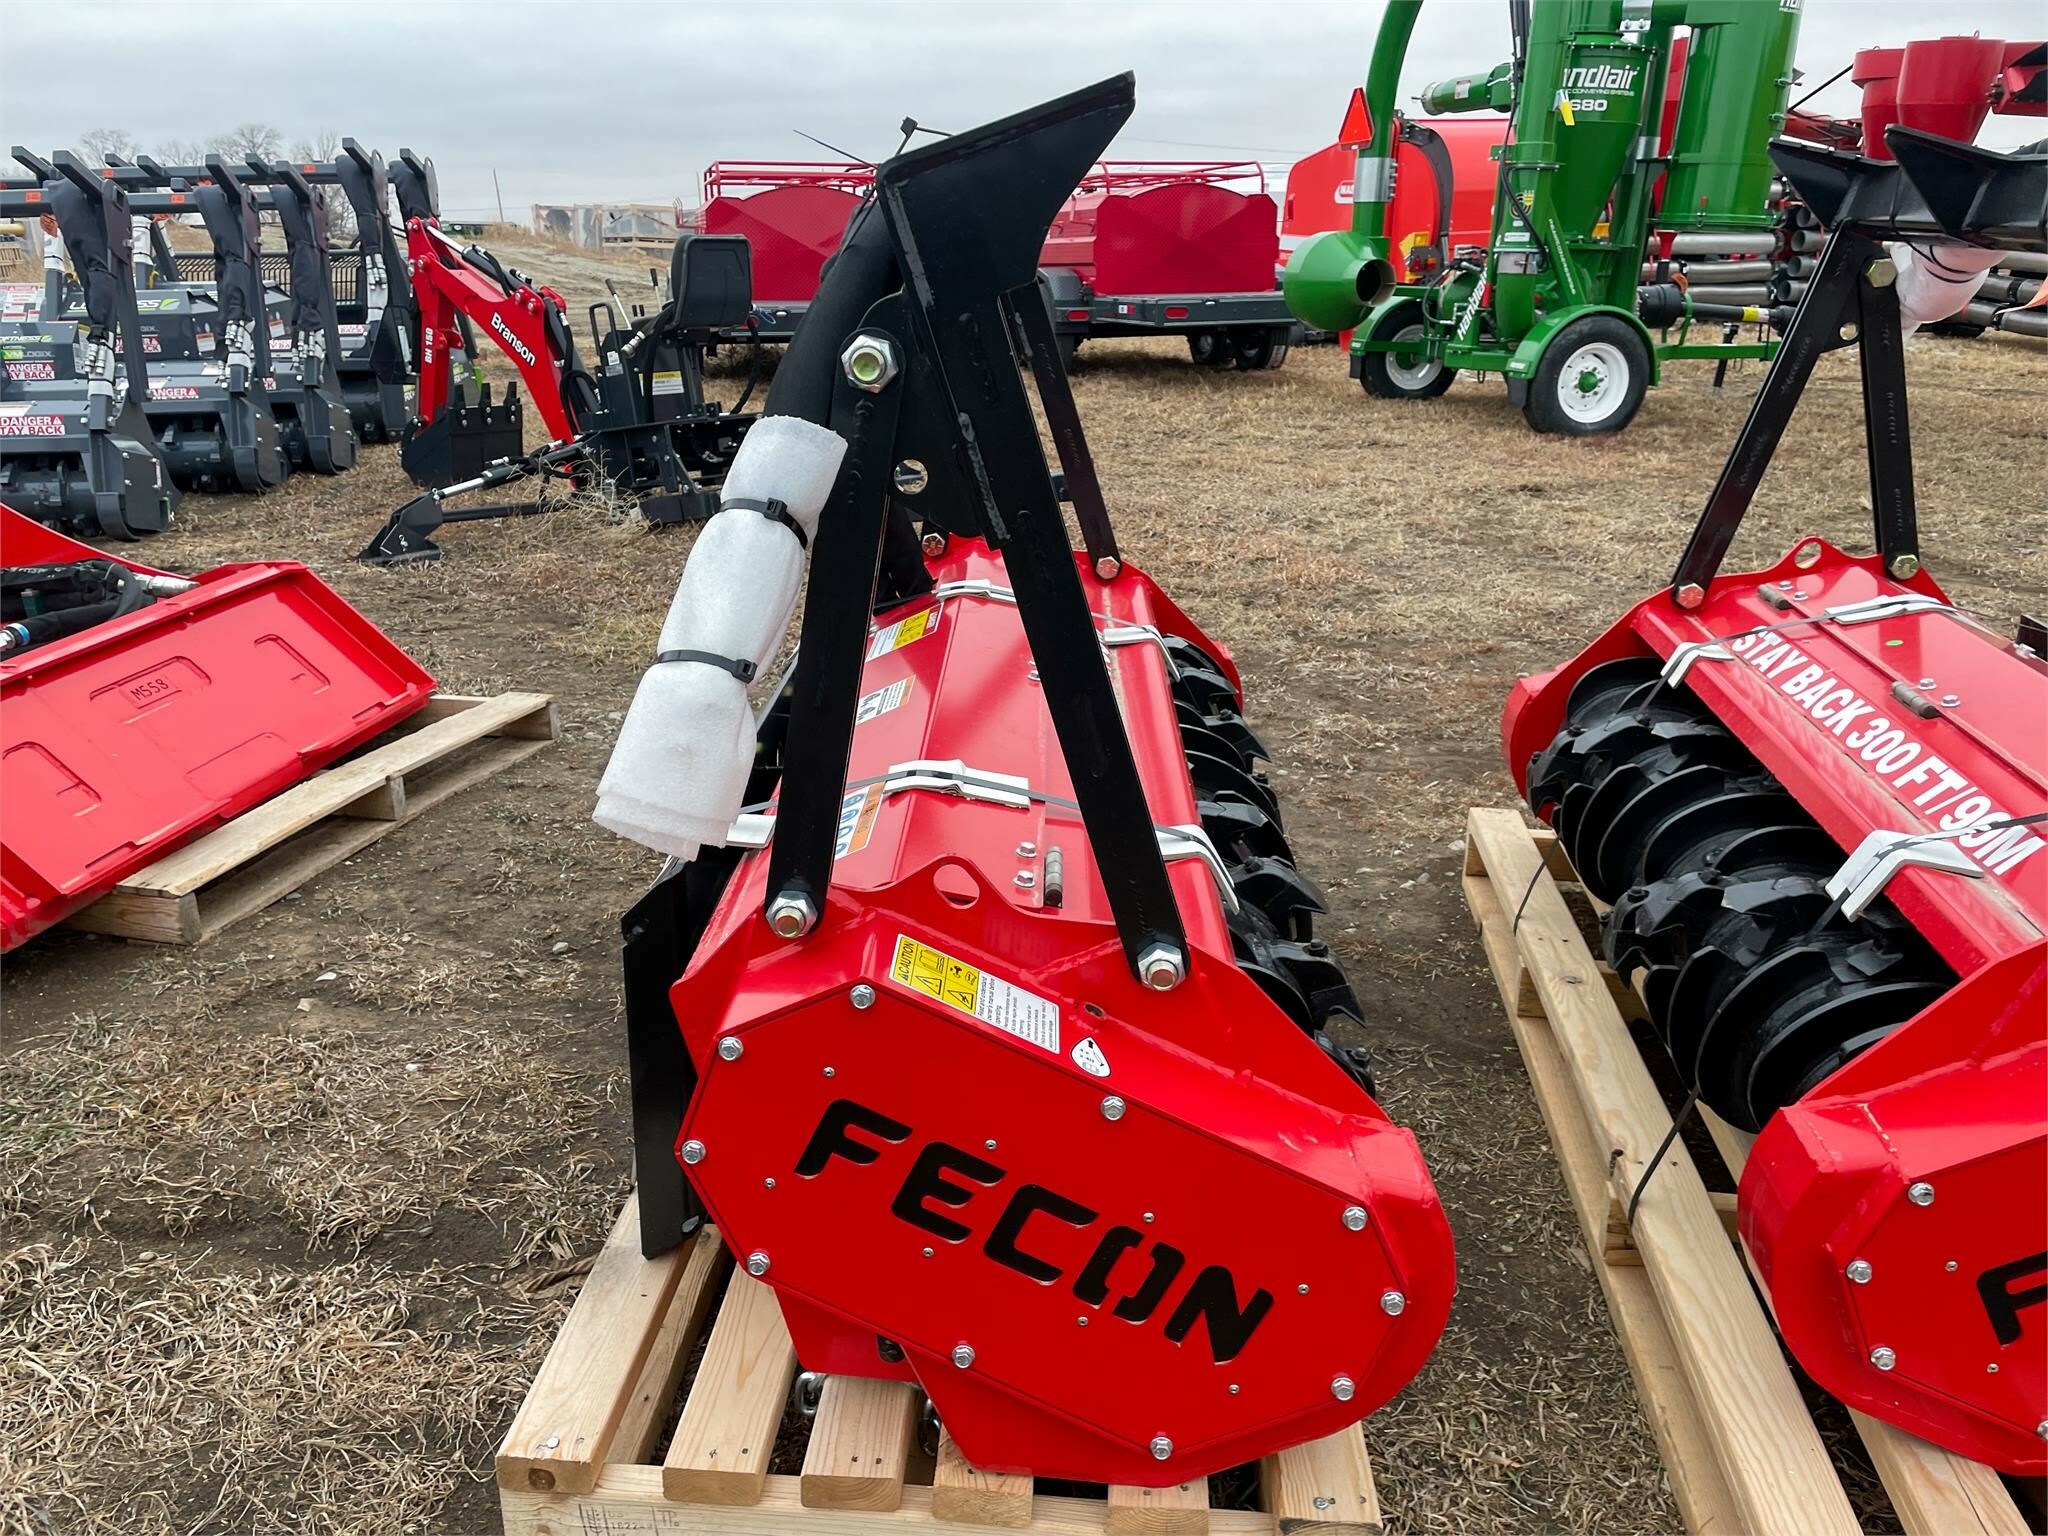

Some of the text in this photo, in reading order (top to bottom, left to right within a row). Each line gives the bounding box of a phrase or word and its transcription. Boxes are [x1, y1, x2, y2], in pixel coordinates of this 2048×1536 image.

[490, 311, 536, 367] Branson
[424, 347, 433, 364] BH
[152, 387, 188, 396] ANGER
[0, 416, 51, 426] DANGER
[0, 426, 62, 435] TAY BACK
[1732, 625, 1809, 680] STAY
[1780, 663, 1876, 737] BACK
[1845, 717, 1922, 774] 300
[898, 940, 916, 975] CAUTION
[794, 1098, 1274, 1365] FECON
